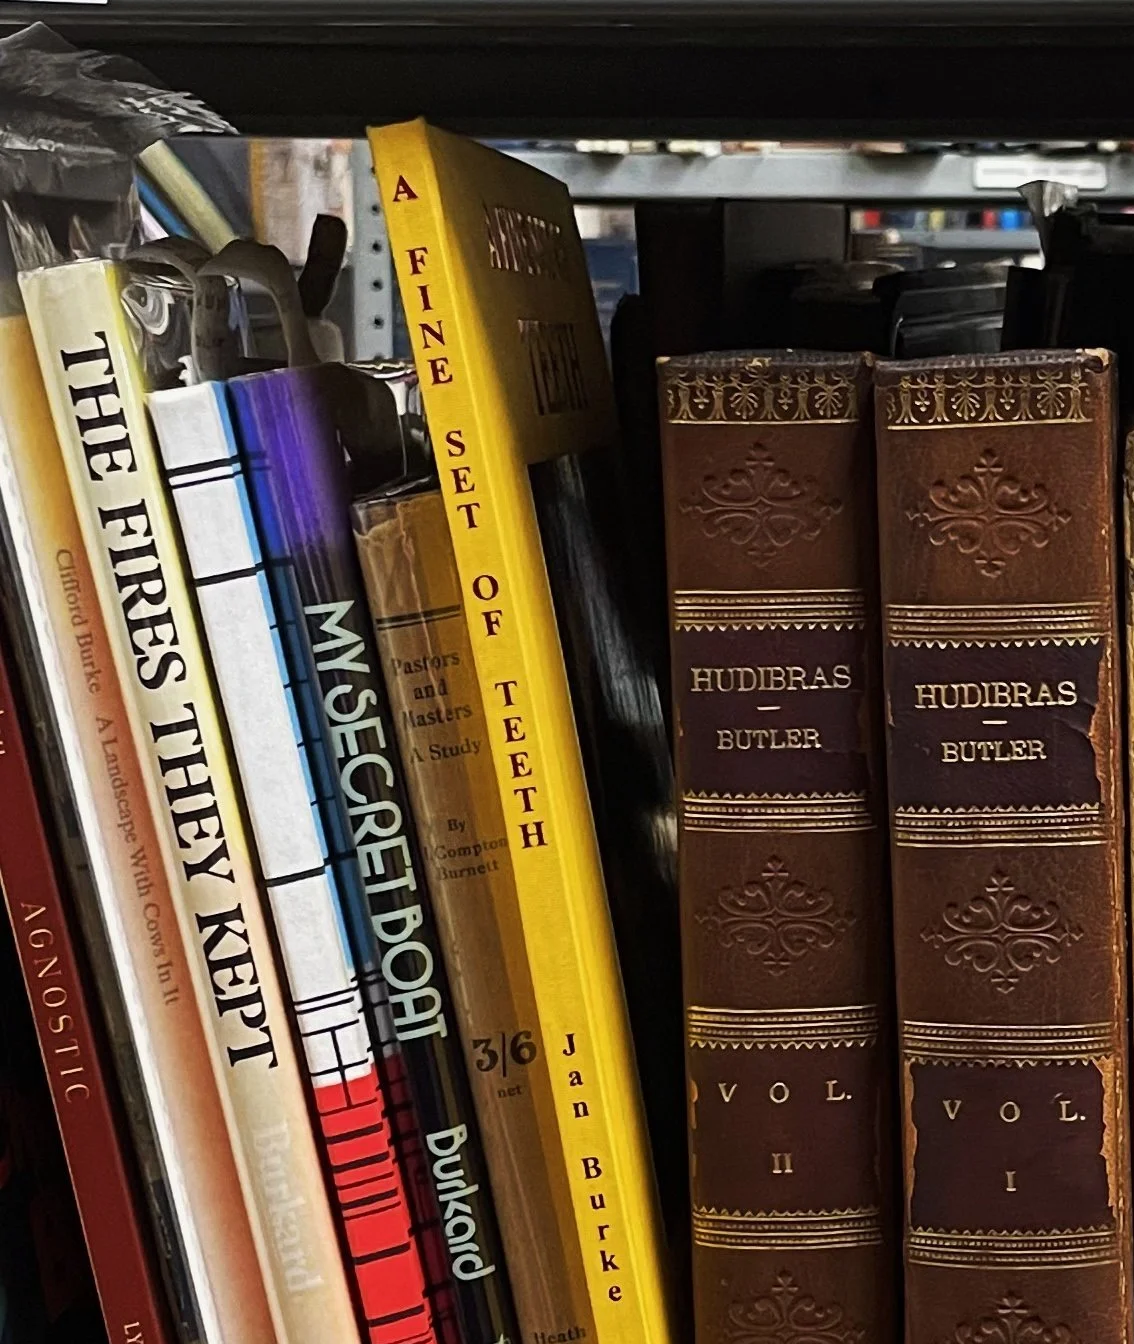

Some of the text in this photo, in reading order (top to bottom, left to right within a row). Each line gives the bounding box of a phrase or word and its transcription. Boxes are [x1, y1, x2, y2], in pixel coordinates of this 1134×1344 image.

[393, 175, 547, 849] A FINE SET OF TEETH
[56, 548, 180, 1006] Clifford Burke A Landscape With Cows In It
[61, 331, 278, 1069] THE FIRES THEY KEPT
[691, 666, 852, 692] HUDIBRAS
[717, 728, 822, 751] BUTLER
[915, 682, 1078, 710] HUDIBRAS
[941, 740, 1046, 763] BUTLER
[304, 599, 448, 1041] MY SECRET BOAT
[20, 902, 90, 1103] AGNOSTIC
[425, 1123, 496, 1281] Burkard
[563, 1033, 621, 1302] Jan Burke
